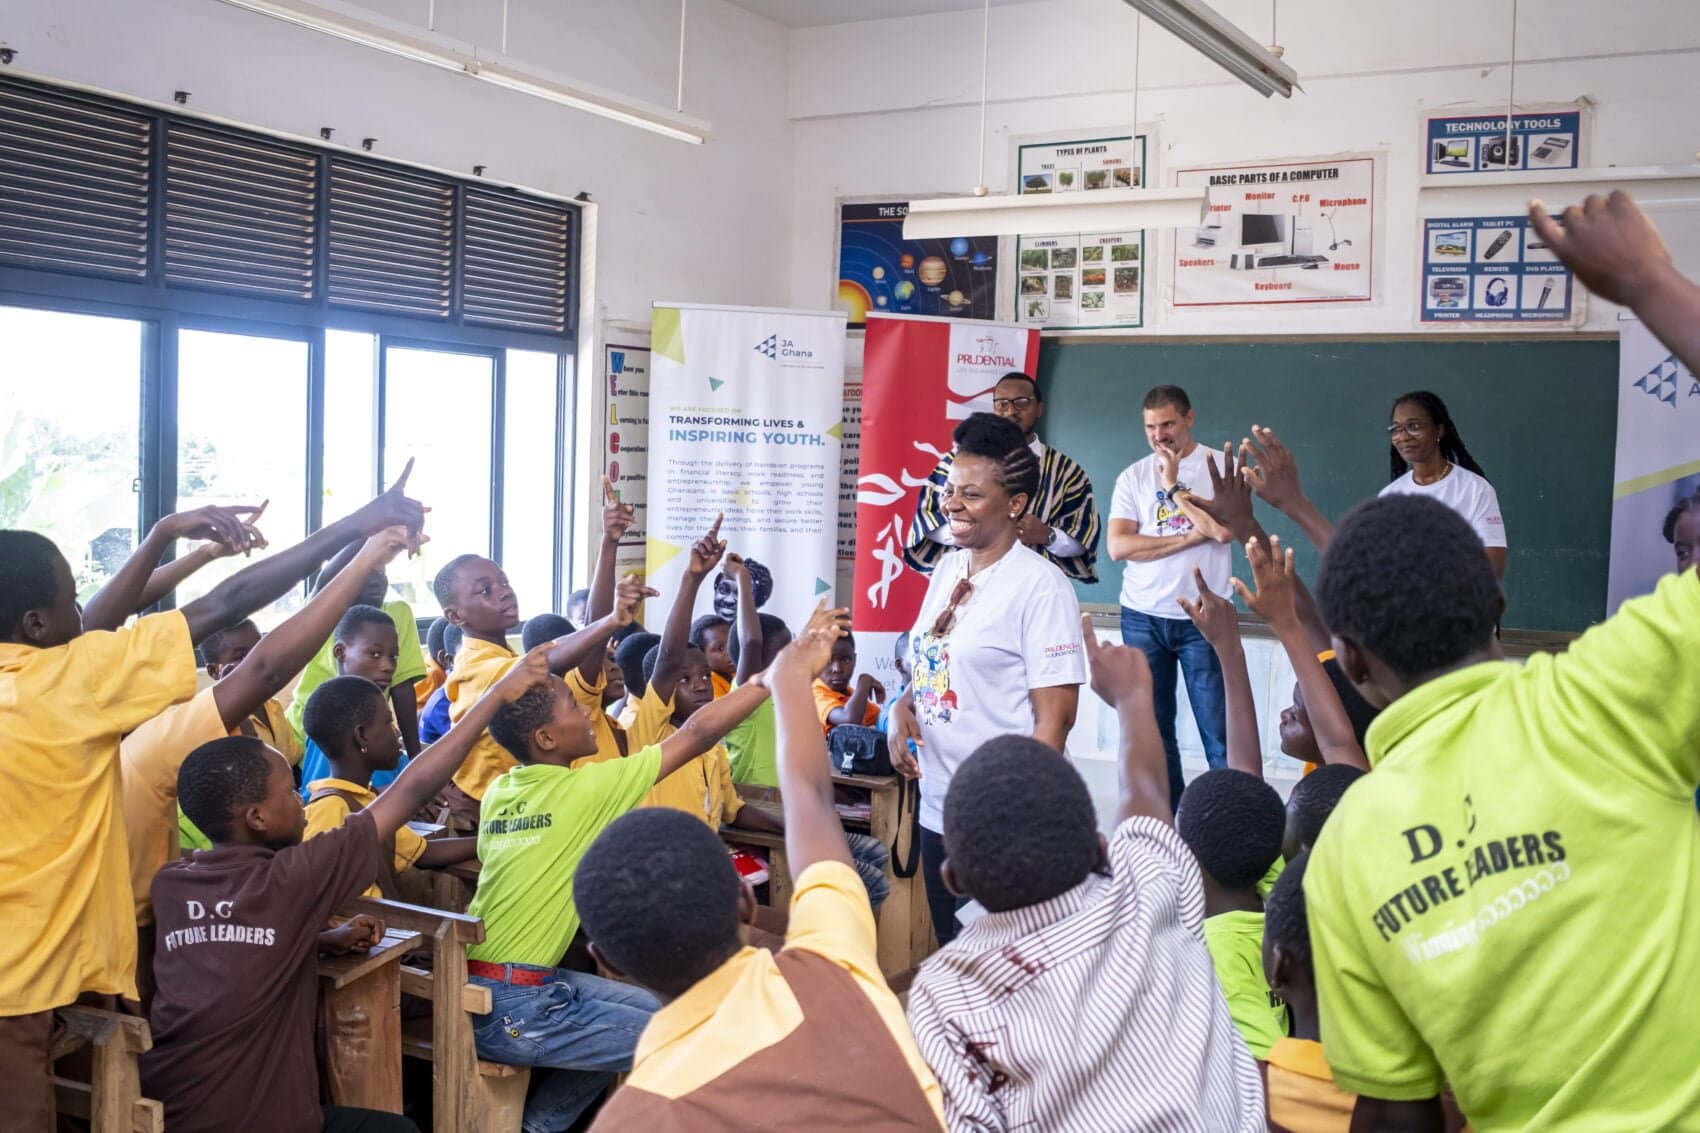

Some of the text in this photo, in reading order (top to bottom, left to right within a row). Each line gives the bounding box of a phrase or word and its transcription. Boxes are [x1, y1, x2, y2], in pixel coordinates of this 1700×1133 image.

[1524, 118, 1561, 129] TOOLS
[1056, 148, 1075, 157] TYPES
[1085, 145, 1107, 154] PLANTS
[1209, 168, 1339, 186] BASIC PARTS OF A COMPUTER
[1245, 192, 1276, 201] Monitor
[1209, 204, 1232, 212] rinter
[1319, 197, 1367, 208] Microphone
[878, 207, 896, 216] THE
[1179, 258, 1215, 268] Speakers
[1334, 261, 1361, 271] Mouse
[1254, 281, 1293, 292] Keyboard
[781, 339, 794, 348] JA
[781, 349, 813, 358] Ghana
[957, 353, 1016, 368] PRUDENTIAL
[669, 415, 805, 428] TRANSFORMING LIVES &
[669, 429, 826, 447] INSPIRING YOUTH.
[1371, 866, 1465, 943] FUTURE
[164, 924, 276, 953] FUTURE LEADERS
